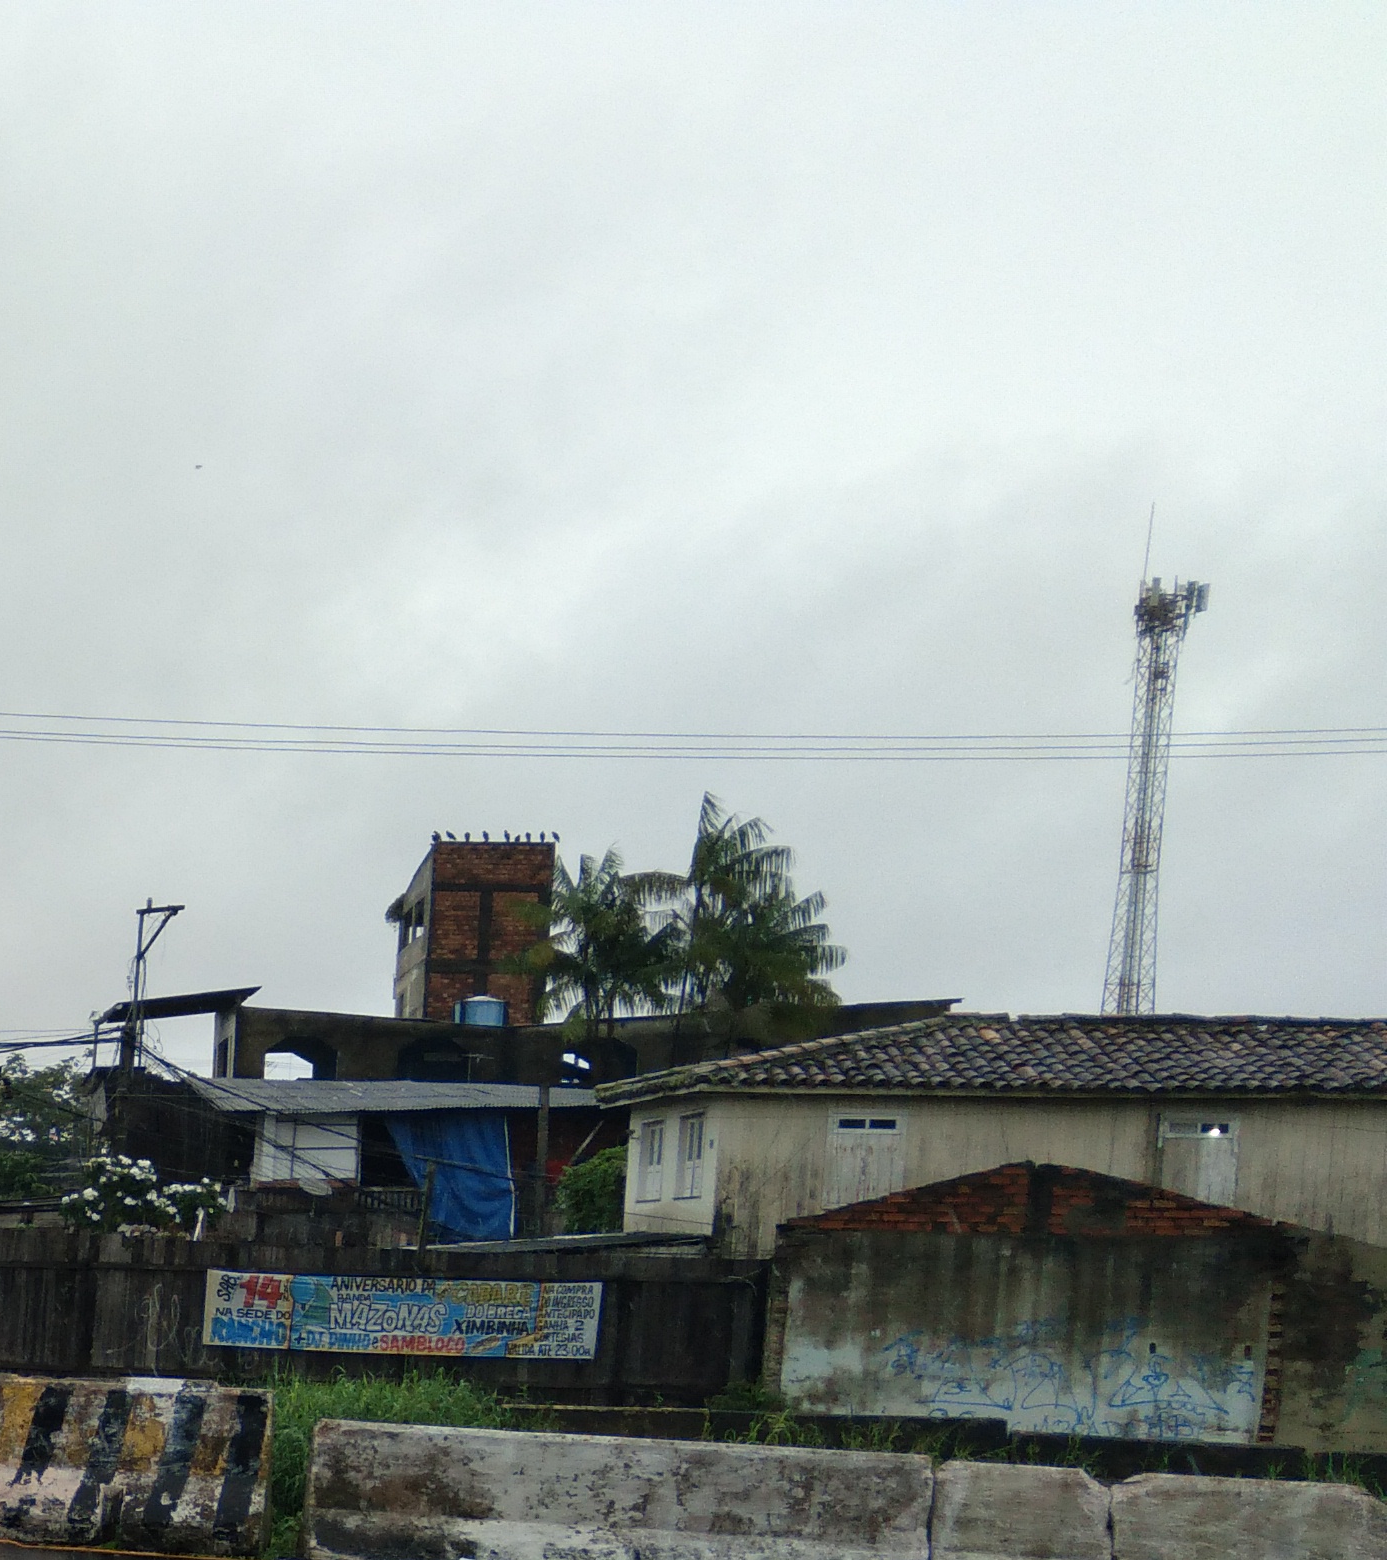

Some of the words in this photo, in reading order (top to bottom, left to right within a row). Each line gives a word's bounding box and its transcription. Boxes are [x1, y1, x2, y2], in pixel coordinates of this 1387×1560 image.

[239, 1275, 283, 1309] 14
[556, 1285, 594, 1295] COMPRA
[215, 1307, 233, 1316] NA
[236, 1308, 273, 1319] SEDE
[276, 1310, 291, 1320] DO
[465, 1304, 485, 1319] DO
[574, 1320, 585, 1331] 2
